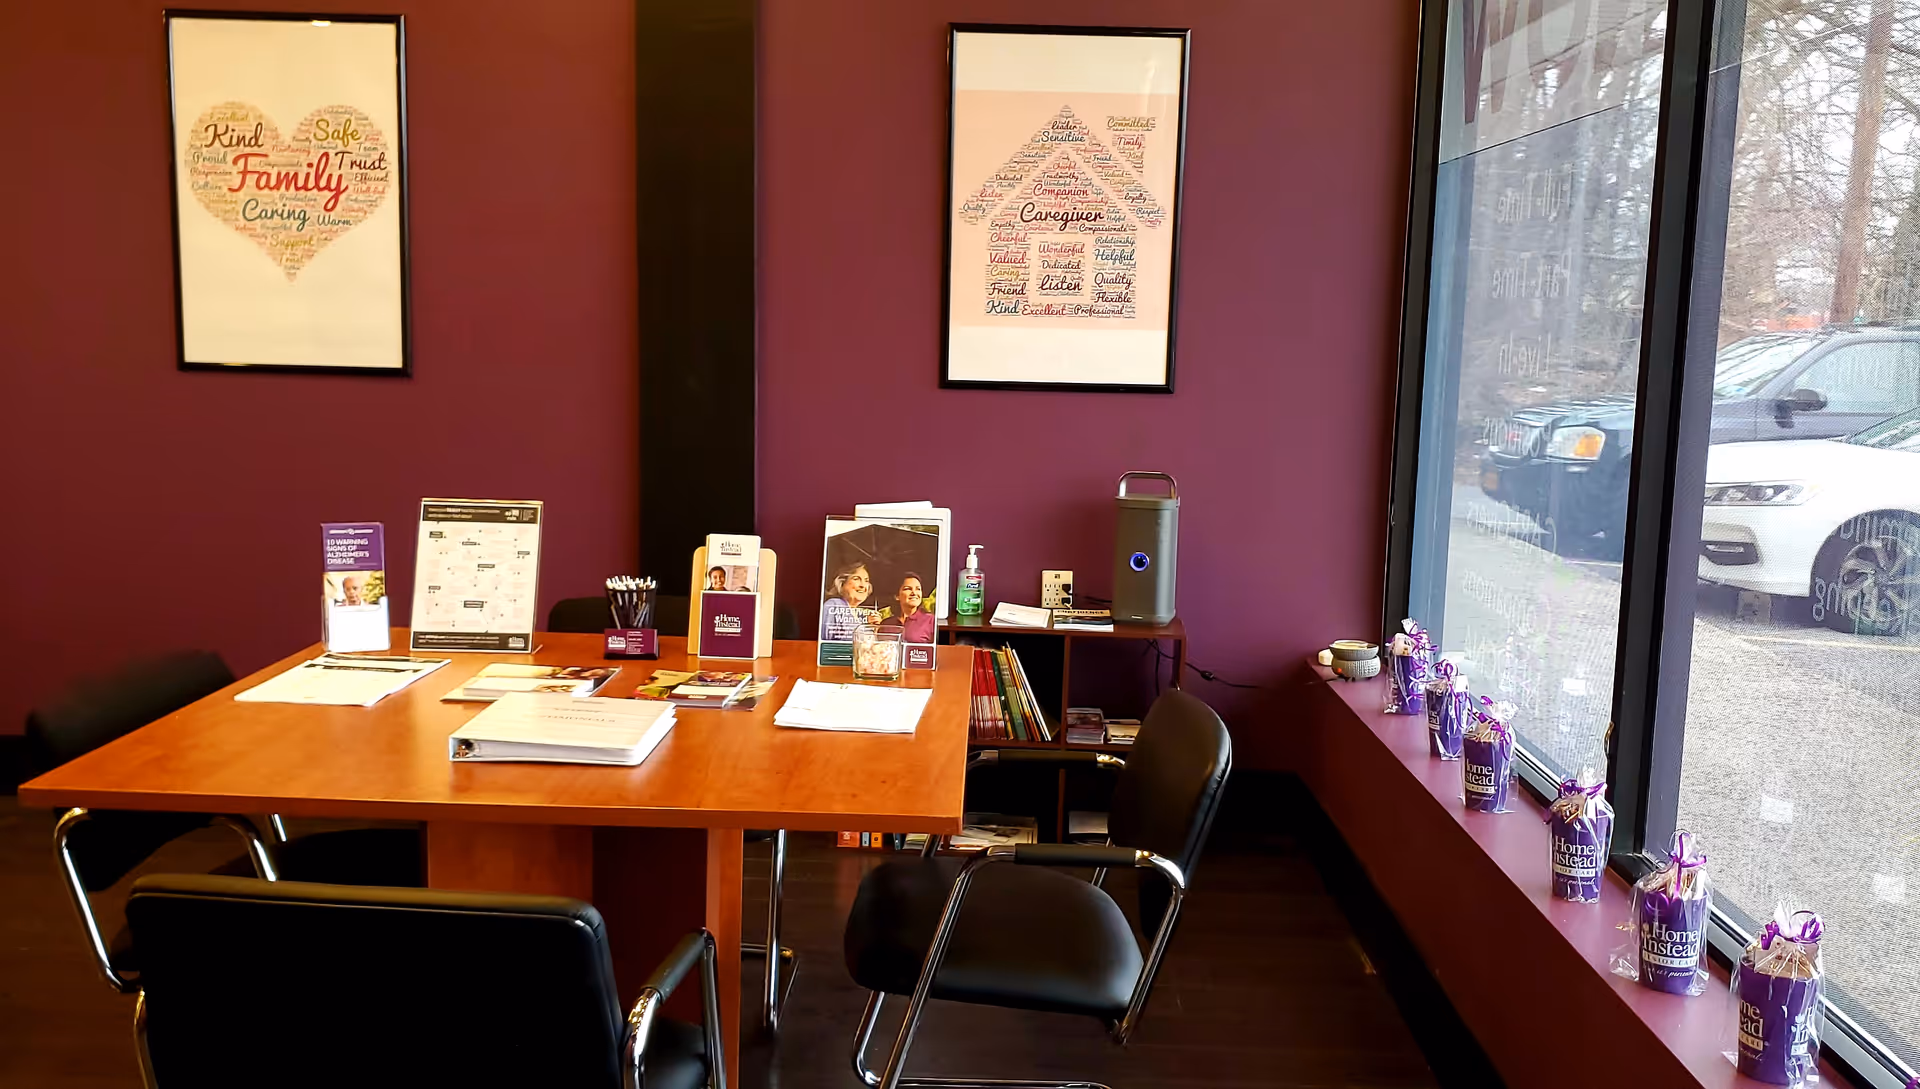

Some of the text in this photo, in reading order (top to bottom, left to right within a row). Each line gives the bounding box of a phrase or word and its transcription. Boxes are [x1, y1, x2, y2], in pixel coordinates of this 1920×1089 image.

[1051, 120, 1077, 130] Leader
[1107, 117, 1150, 129] Committed
[204, 122, 264, 149] Kind
[313, 118, 361, 148] Safe
[1041, 130, 1086, 143] Sensitive
[1115, 136, 1143, 150] Timely
[192, 151, 229, 164] Proud
[335, 151, 388, 171] Trust
[1020, 151, 1047, 159] Sensitive
[1092, 154, 1113, 162] Friend
[1125, 151, 1145, 160] Kind
[1053, 161, 1077, 171] Cheerful
[227, 152, 349, 213] Family
[1042, 172, 1080, 182] Trustworthy
[979, 188, 1004, 198] Listen
[1032, 183, 1090, 200] Companion
[1124, 192, 1147, 204] Loyalty
[242, 198, 311, 232] Caring
[962, 202, 986, 214] Quality
[1136, 207, 1161, 217] Respect
[317, 214, 353, 227] Warm
[1020, 201, 1105, 232] Caregiver
[990, 220, 1016, 231] Empathy
[1078, 223, 1128, 235] Compassionate
[270, 234, 314, 251] Support
[990, 231, 1029, 245] Cheerful
[1095, 236, 1136, 247] Relationship
[989, 250, 1027, 264] Valued
[1038, 243, 1085, 257] Wonderful
[1094, 248, 1136, 266] Helpful
[1041, 260, 1082, 270] Dedicated
[990, 266, 1020, 280] Caring
[1037, 274, 1083, 292] Listen
[1094, 272, 1134, 290] Quality
[987, 282, 1027, 296] Friend
[1093, 291, 1133, 303] Flexible
[985, 299, 1021, 315] Kind
[1021, 303, 1067, 317] Excellent
[1073, 304, 1126, 317] Professional
[720, 614, 740, 623] Home
[834, 615, 868, 624] Wanted
[1465, 772, 1495, 786] stead
[1555, 835, 1595, 856] Home
[1553, 850, 1596, 868] nstead
[1652, 922, 1699, 943] Home
[1642, 935, 1699, 957] Instead
[1740, 999, 1761, 1019] me
